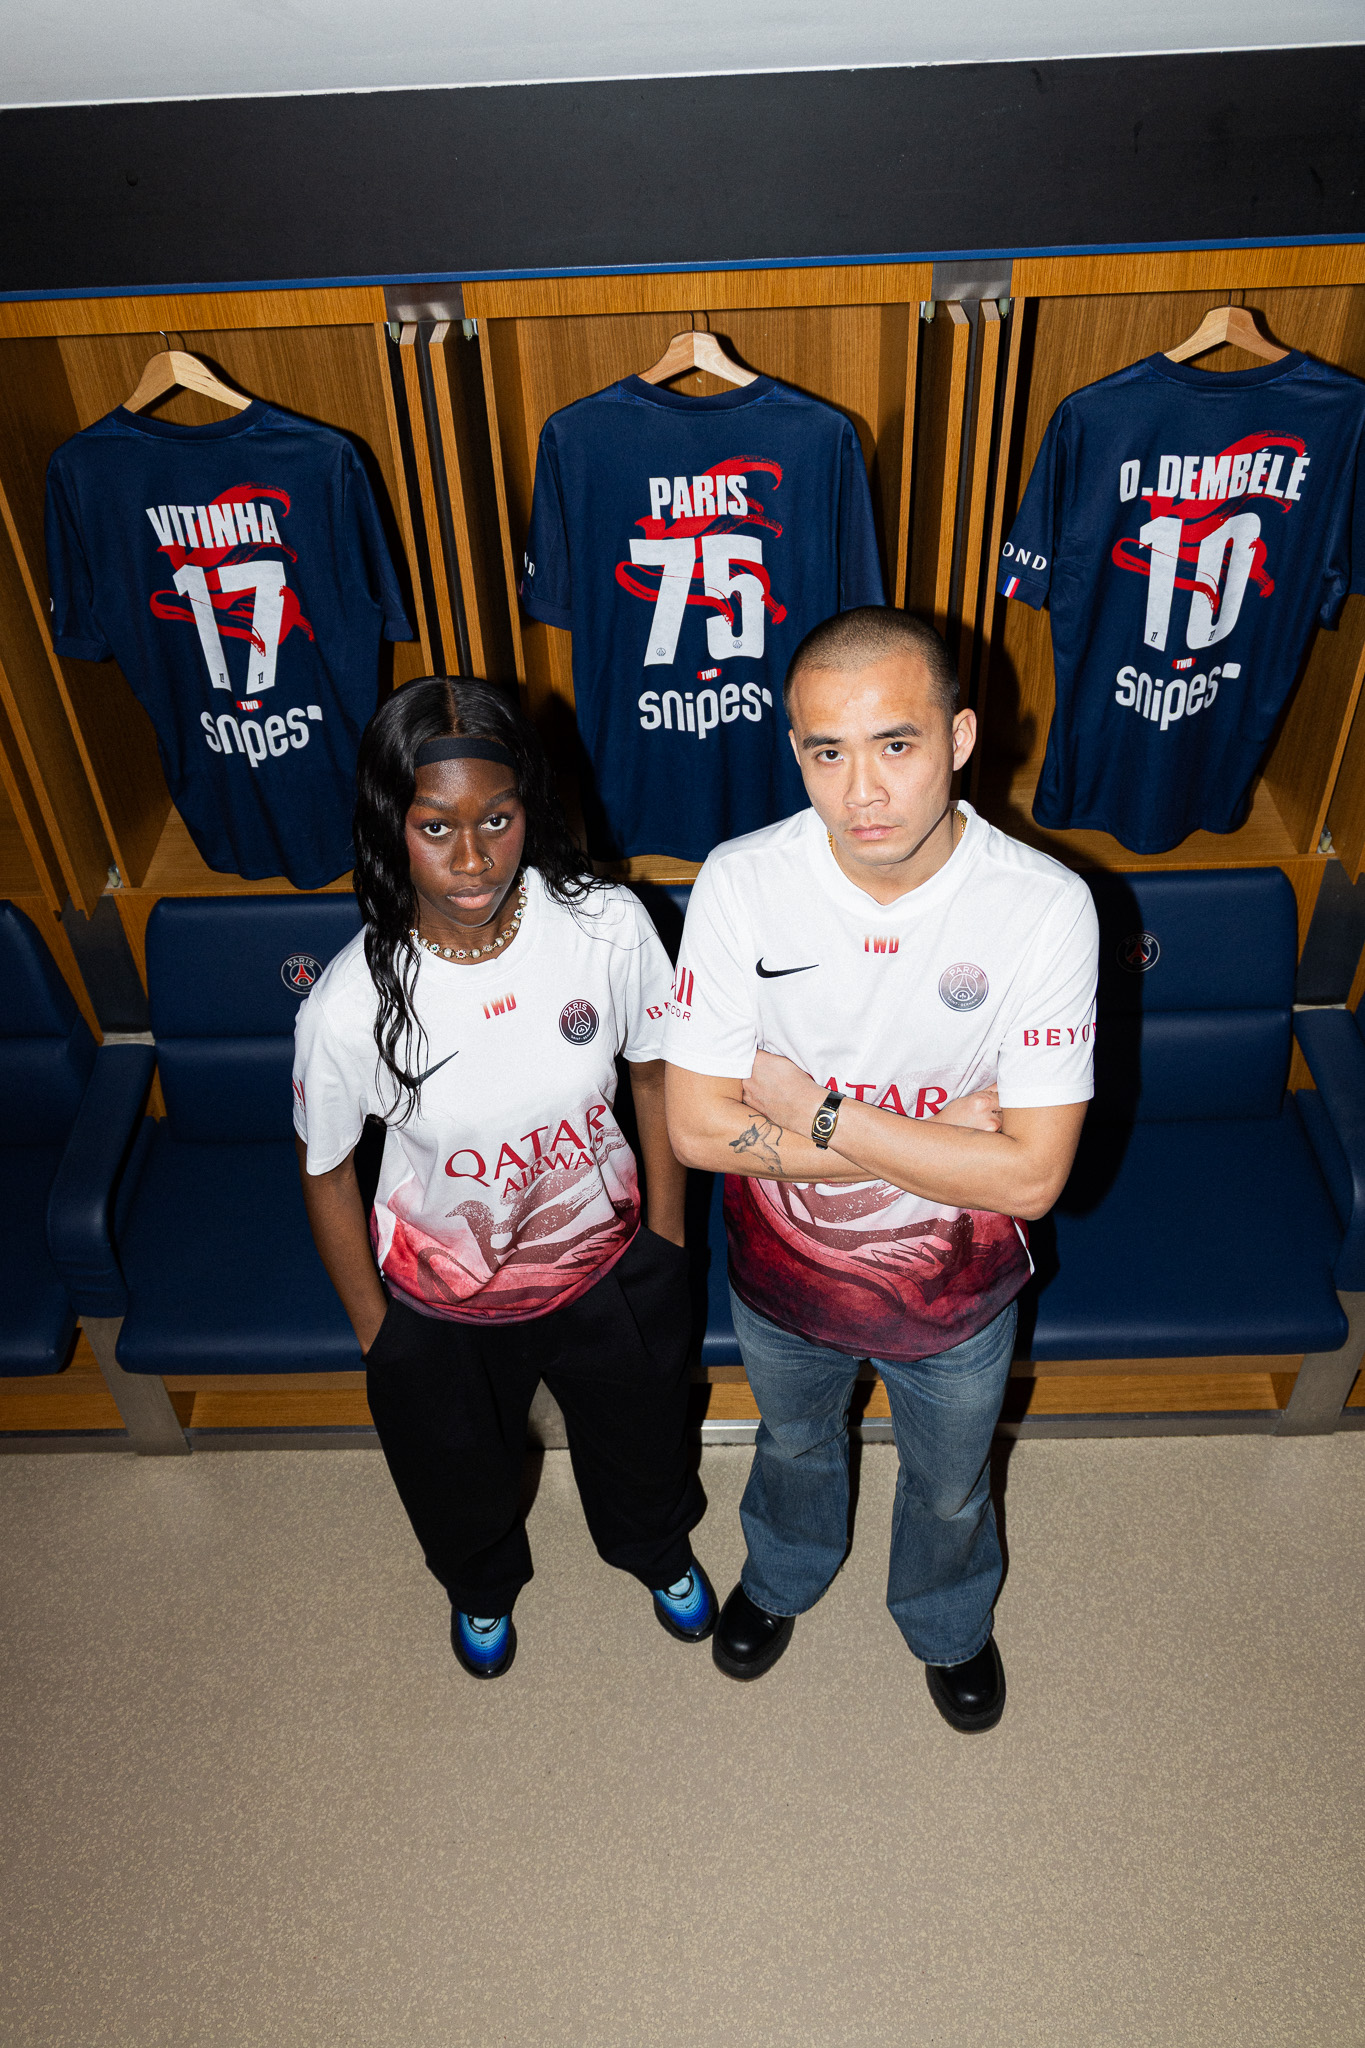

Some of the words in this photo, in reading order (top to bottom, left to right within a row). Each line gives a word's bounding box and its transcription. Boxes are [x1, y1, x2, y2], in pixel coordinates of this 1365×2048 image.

[145, 502, 282, 549] VITINHA
[649, 474, 748, 520] PARIS
[628, 533, 765, 667] 75
[1138, 512, 1262, 652] 10
[172, 560, 287, 694] 17
[638, 682, 762, 740] snipes
[1115, 664, 1222, 731] snipes
[200, 707, 310, 768] snpes
[286, 957, 315, 967] PARIS
[949, 966, 981, 979] PARIS
[563, 1002, 588, 1018] PARIS
[823, 1076, 948, 1118] TAR
[445, 1104, 607, 1188] QATAR
